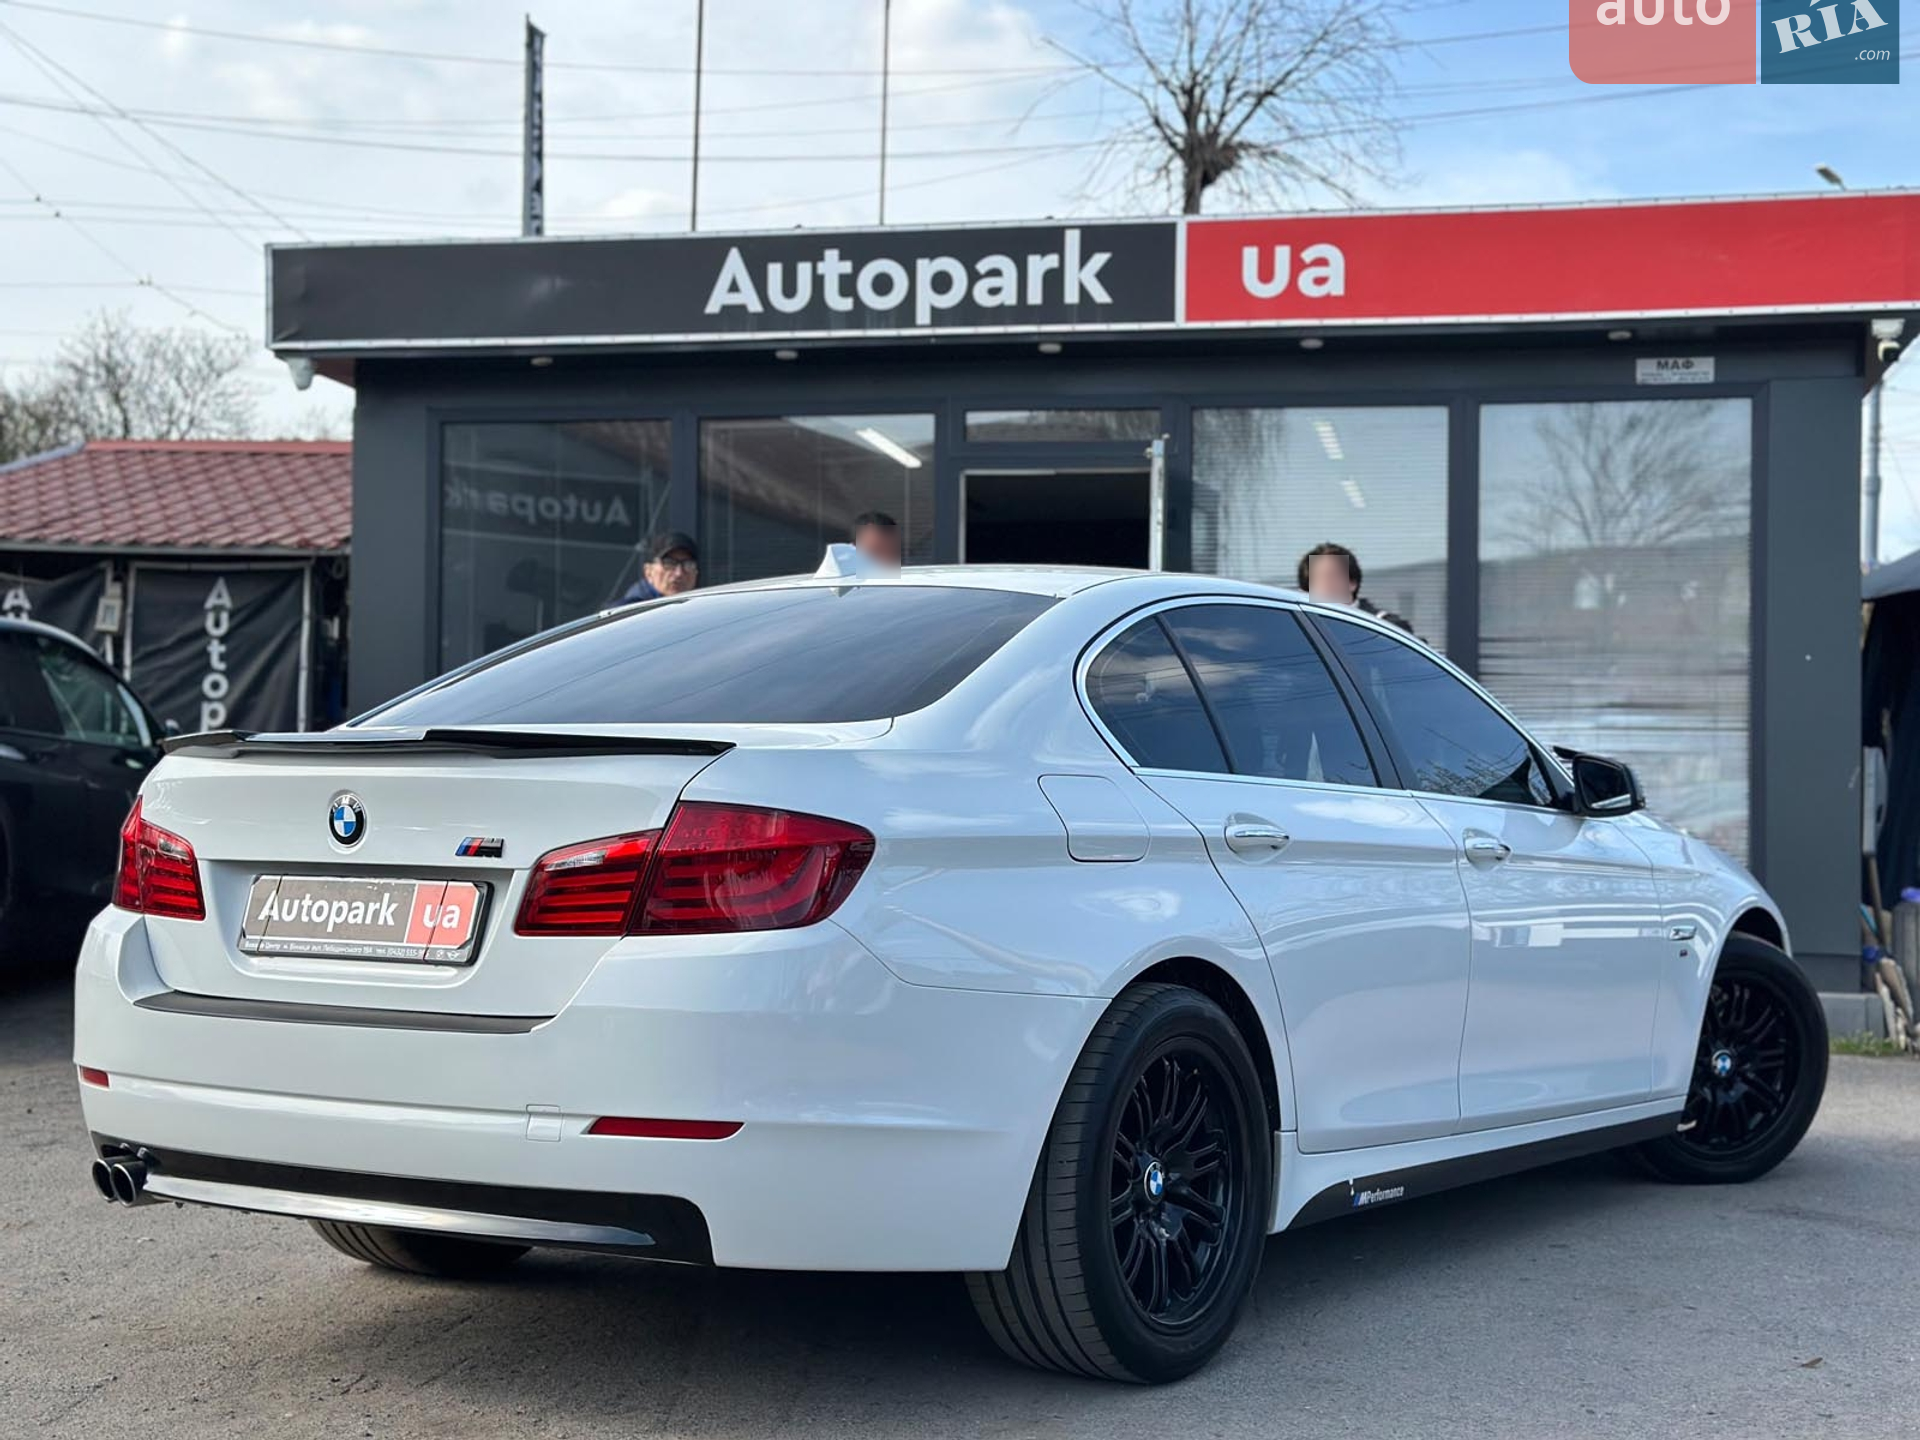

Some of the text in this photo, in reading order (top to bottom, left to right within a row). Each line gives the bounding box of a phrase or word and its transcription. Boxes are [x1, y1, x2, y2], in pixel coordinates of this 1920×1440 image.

[704, 228, 1346, 325] Autopark ua
[1656, 359, 1694, 371] МАФ
[257, 889, 462, 933] Autopark ua
